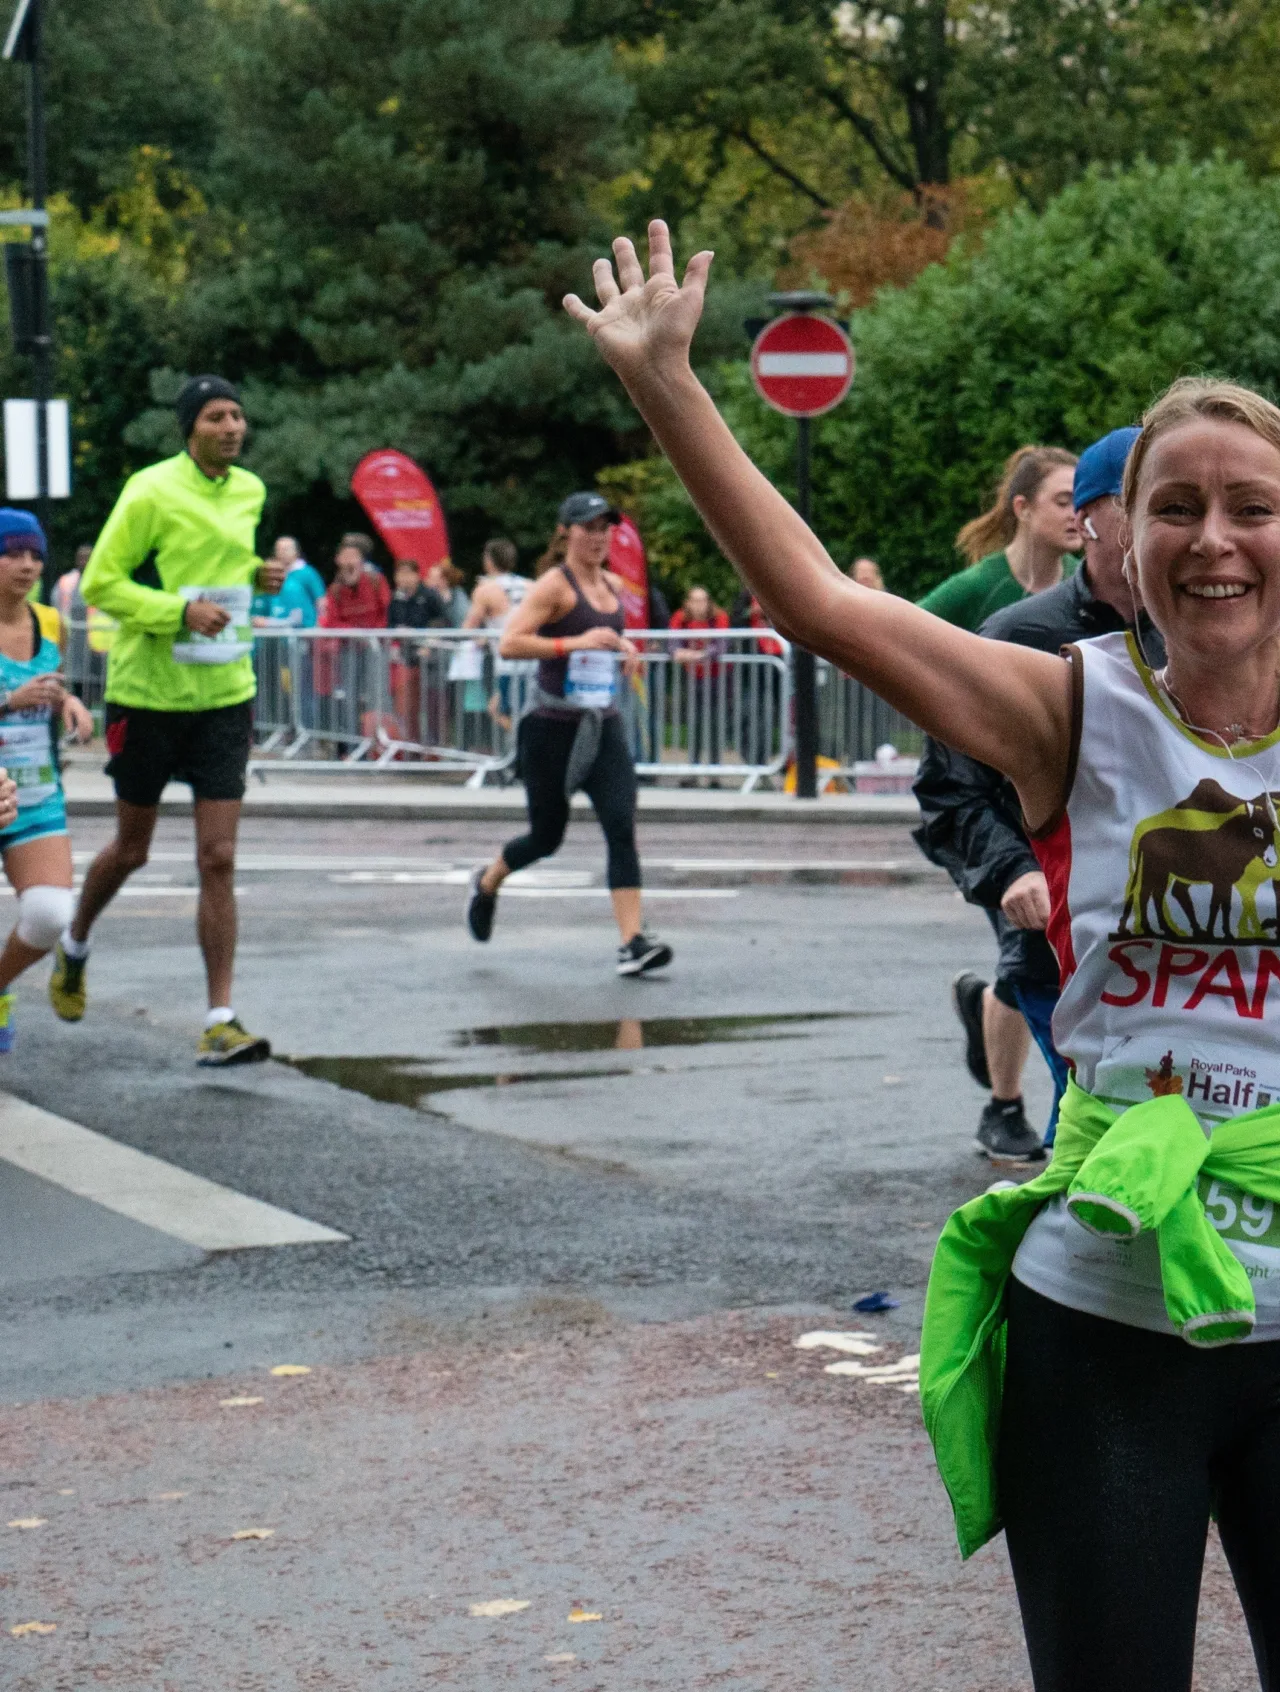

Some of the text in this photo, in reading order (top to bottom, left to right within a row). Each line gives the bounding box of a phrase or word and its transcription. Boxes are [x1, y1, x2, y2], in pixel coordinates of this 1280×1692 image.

[1190, 1058, 1257, 1079] Royal Parks
[1187, 1071, 1255, 1108] Half
[1205, 1180, 1275, 1238] 59
